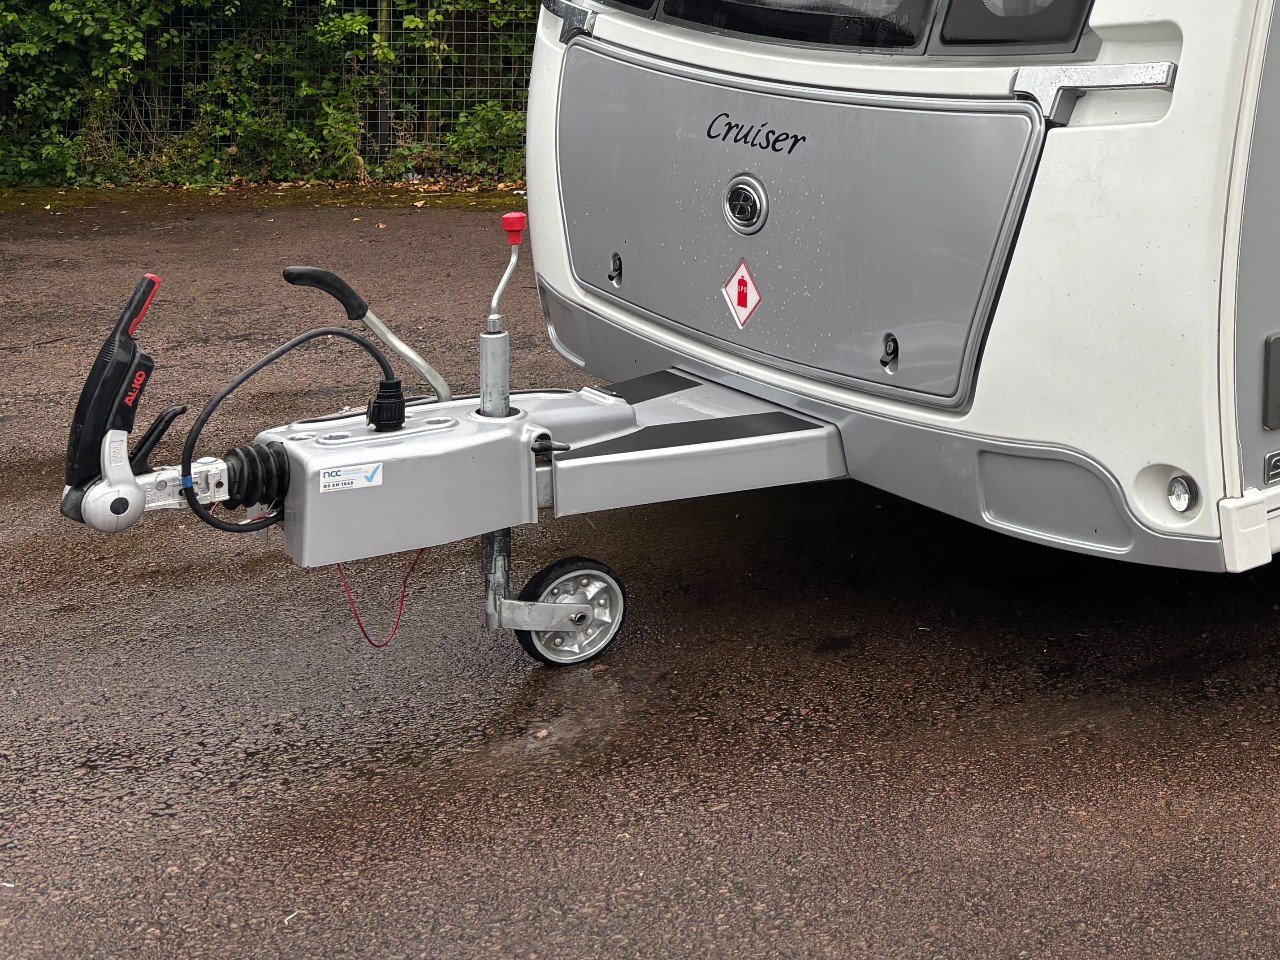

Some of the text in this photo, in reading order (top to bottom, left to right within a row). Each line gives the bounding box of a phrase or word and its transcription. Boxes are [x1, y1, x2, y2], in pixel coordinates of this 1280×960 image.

[706, 112, 807, 155] Cruiser
[124, 370, 147, 407] AL-KO
[323, 470, 342, 478] ncc
